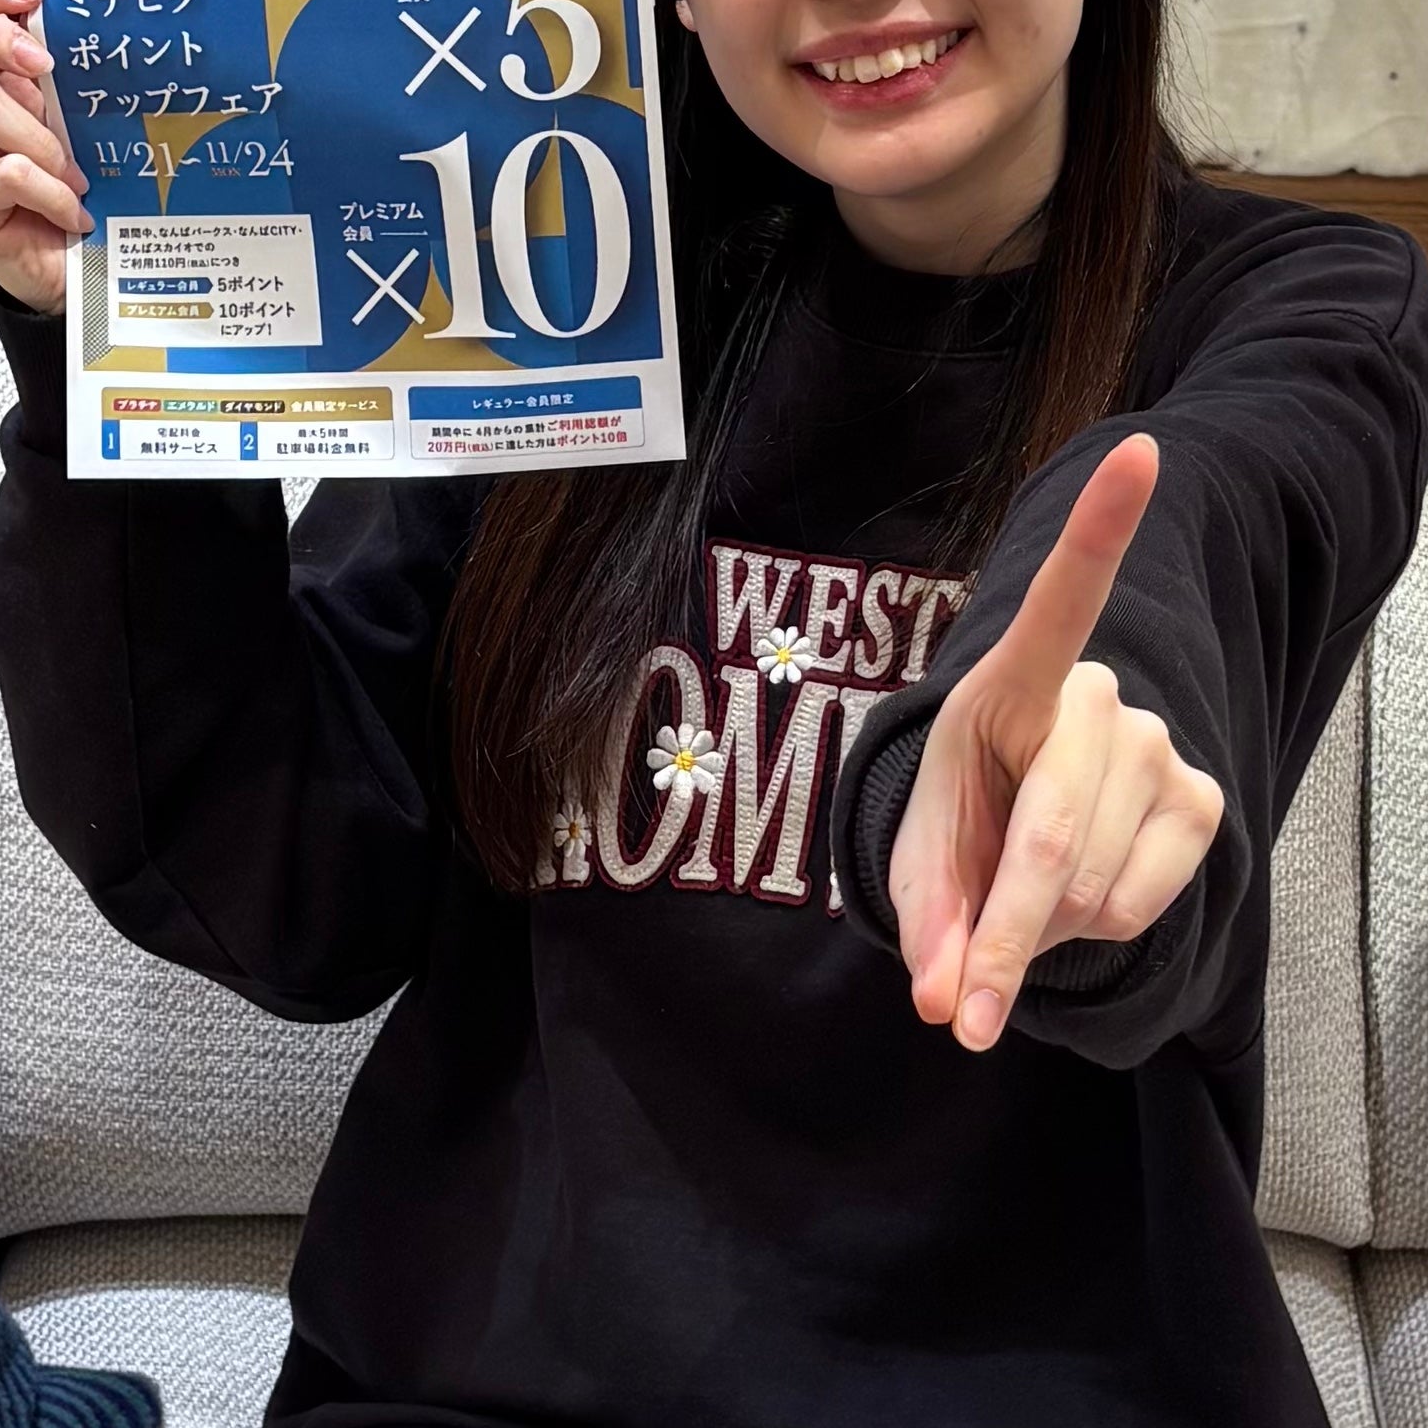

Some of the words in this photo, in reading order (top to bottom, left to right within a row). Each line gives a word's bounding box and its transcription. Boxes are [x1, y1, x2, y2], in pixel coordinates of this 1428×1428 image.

[68, 31, 203, 71] ポイント
[77, 82, 283, 118] アップフェア
[339, 201, 425, 221] プレミアム
[342, 225, 374, 242] 会員
[119, 242, 215, 254] なんばスカイオでの
[126, 280, 200, 292] レギュラー会員
[217, 276, 284, 293] 5ポイント
[126, 305, 201, 317] プレミアム会員
[218, 302, 296, 319] 10ポイント
[472, 393, 575, 410] レギュラー会員限定
[107, 432, 114, 450] 1
[140, 442, 218, 455] 無料サービス
[243, 433, 255, 451] 2
